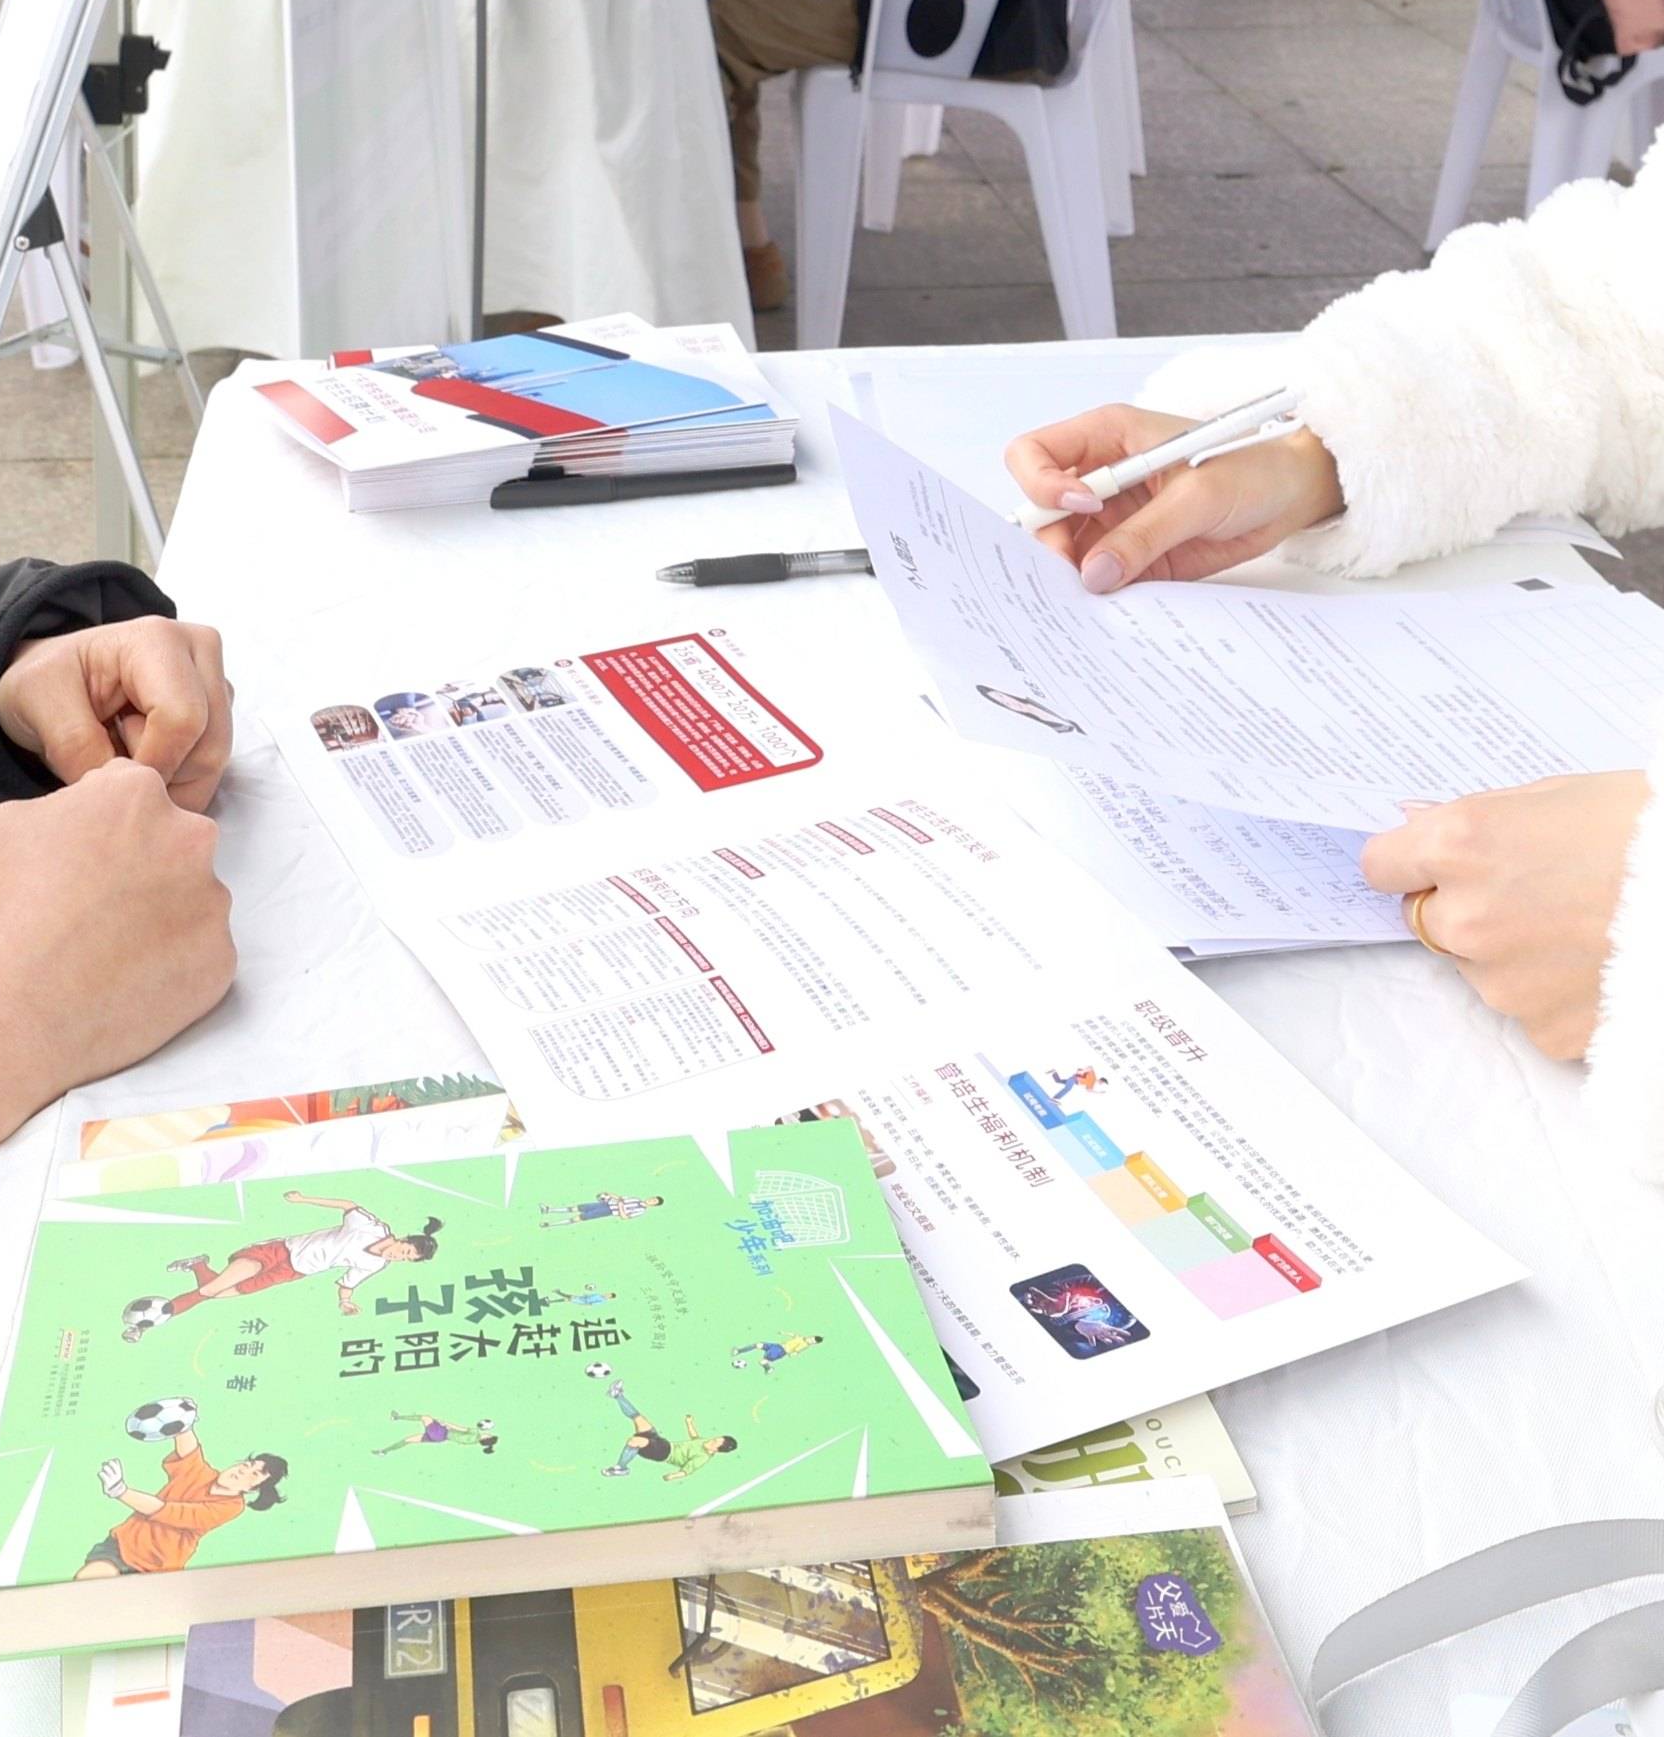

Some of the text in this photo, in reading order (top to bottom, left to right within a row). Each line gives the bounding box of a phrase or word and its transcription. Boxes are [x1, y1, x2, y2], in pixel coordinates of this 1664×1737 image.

[1134, 999, 1208, 1065] 职级晋升
[902, 1072, 935, 1106] 工作福利
[933, 1062, 1055, 1188] 管培生福利机制
[887, 1181, 937, 1233] 毕业论文假期
[724, 1218, 773, 1276] 少年系列
[1267, 1252, 1304, 1284] 部门负责人
[375, 1264, 546, 1327] 孩子
[643, 1286, 667, 1351] 三代传承中国情
[226, 1317, 268, 1394] 余雷 著
[336, 1315, 631, 1378] 追赶太阳的
[1146, 1592, 1178, 1642] 一片天
[1155, 1580, 1190, 1618] 父爱
